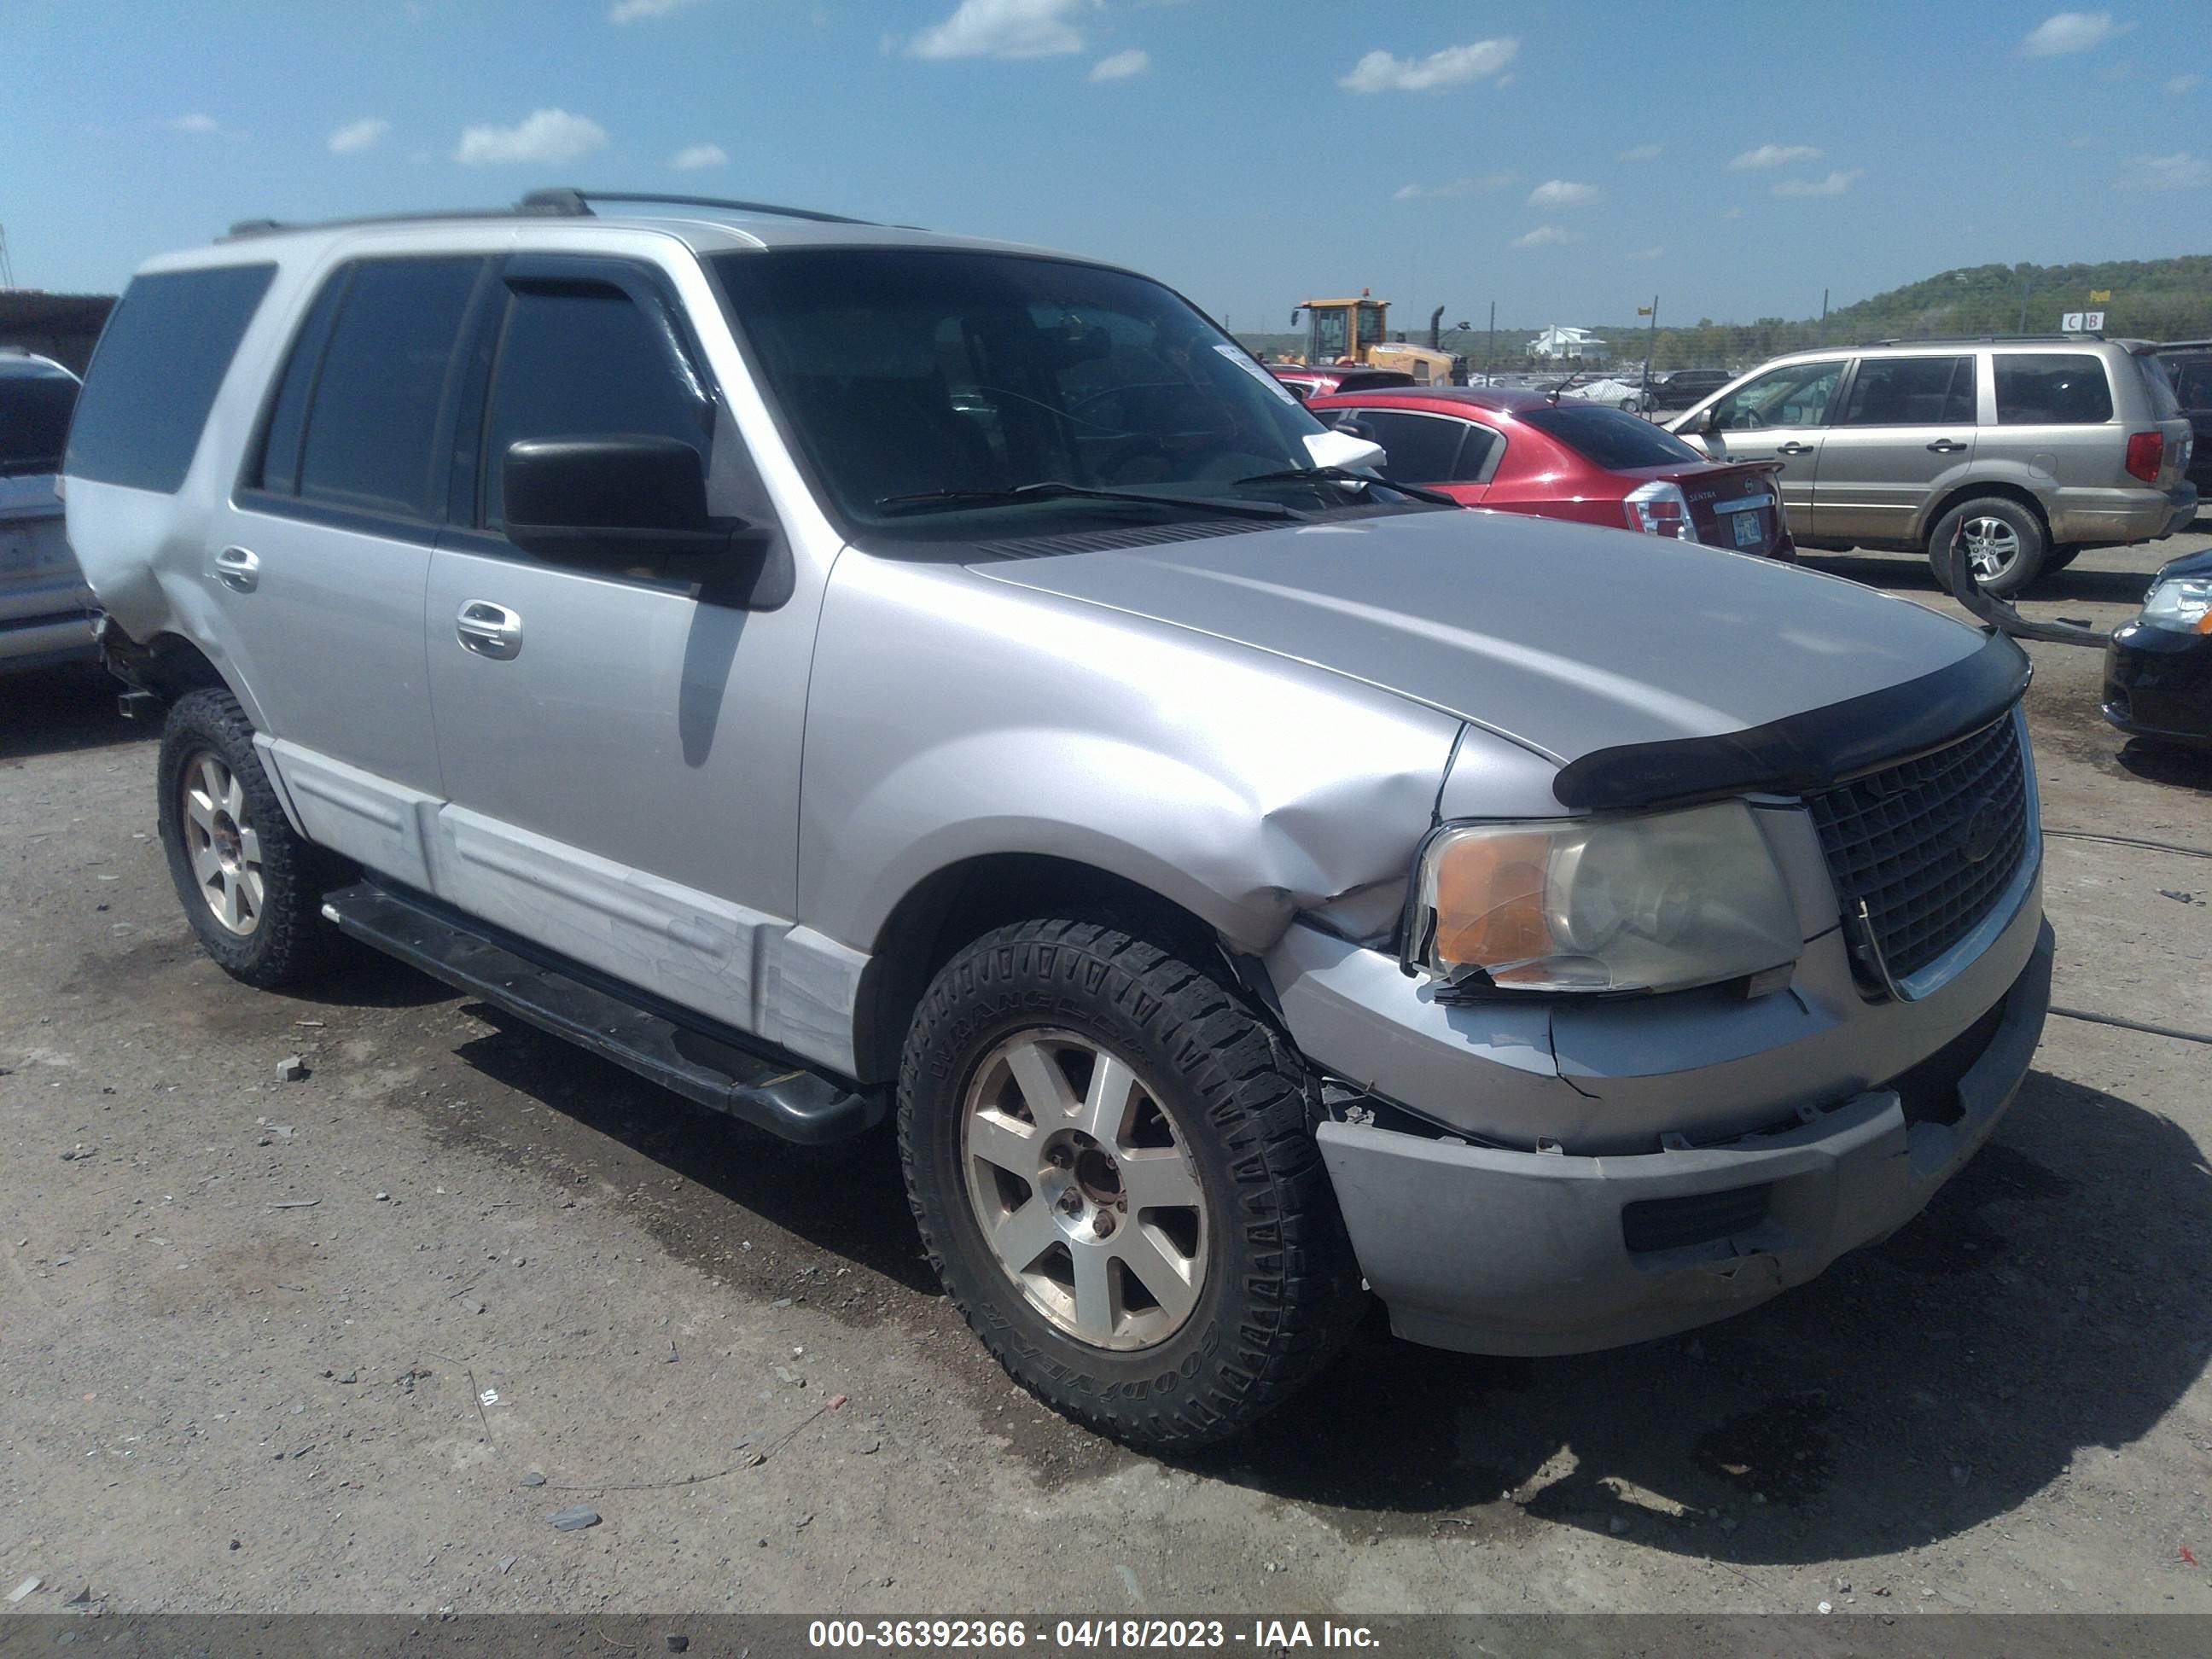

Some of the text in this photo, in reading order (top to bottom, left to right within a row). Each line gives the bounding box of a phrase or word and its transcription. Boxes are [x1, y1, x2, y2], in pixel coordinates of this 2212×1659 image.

[2068, 314, 2098, 329] C B
[1689, 491, 1716, 503] SENTRA
[980, 1302, 1220, 1403] GOODYEAR
